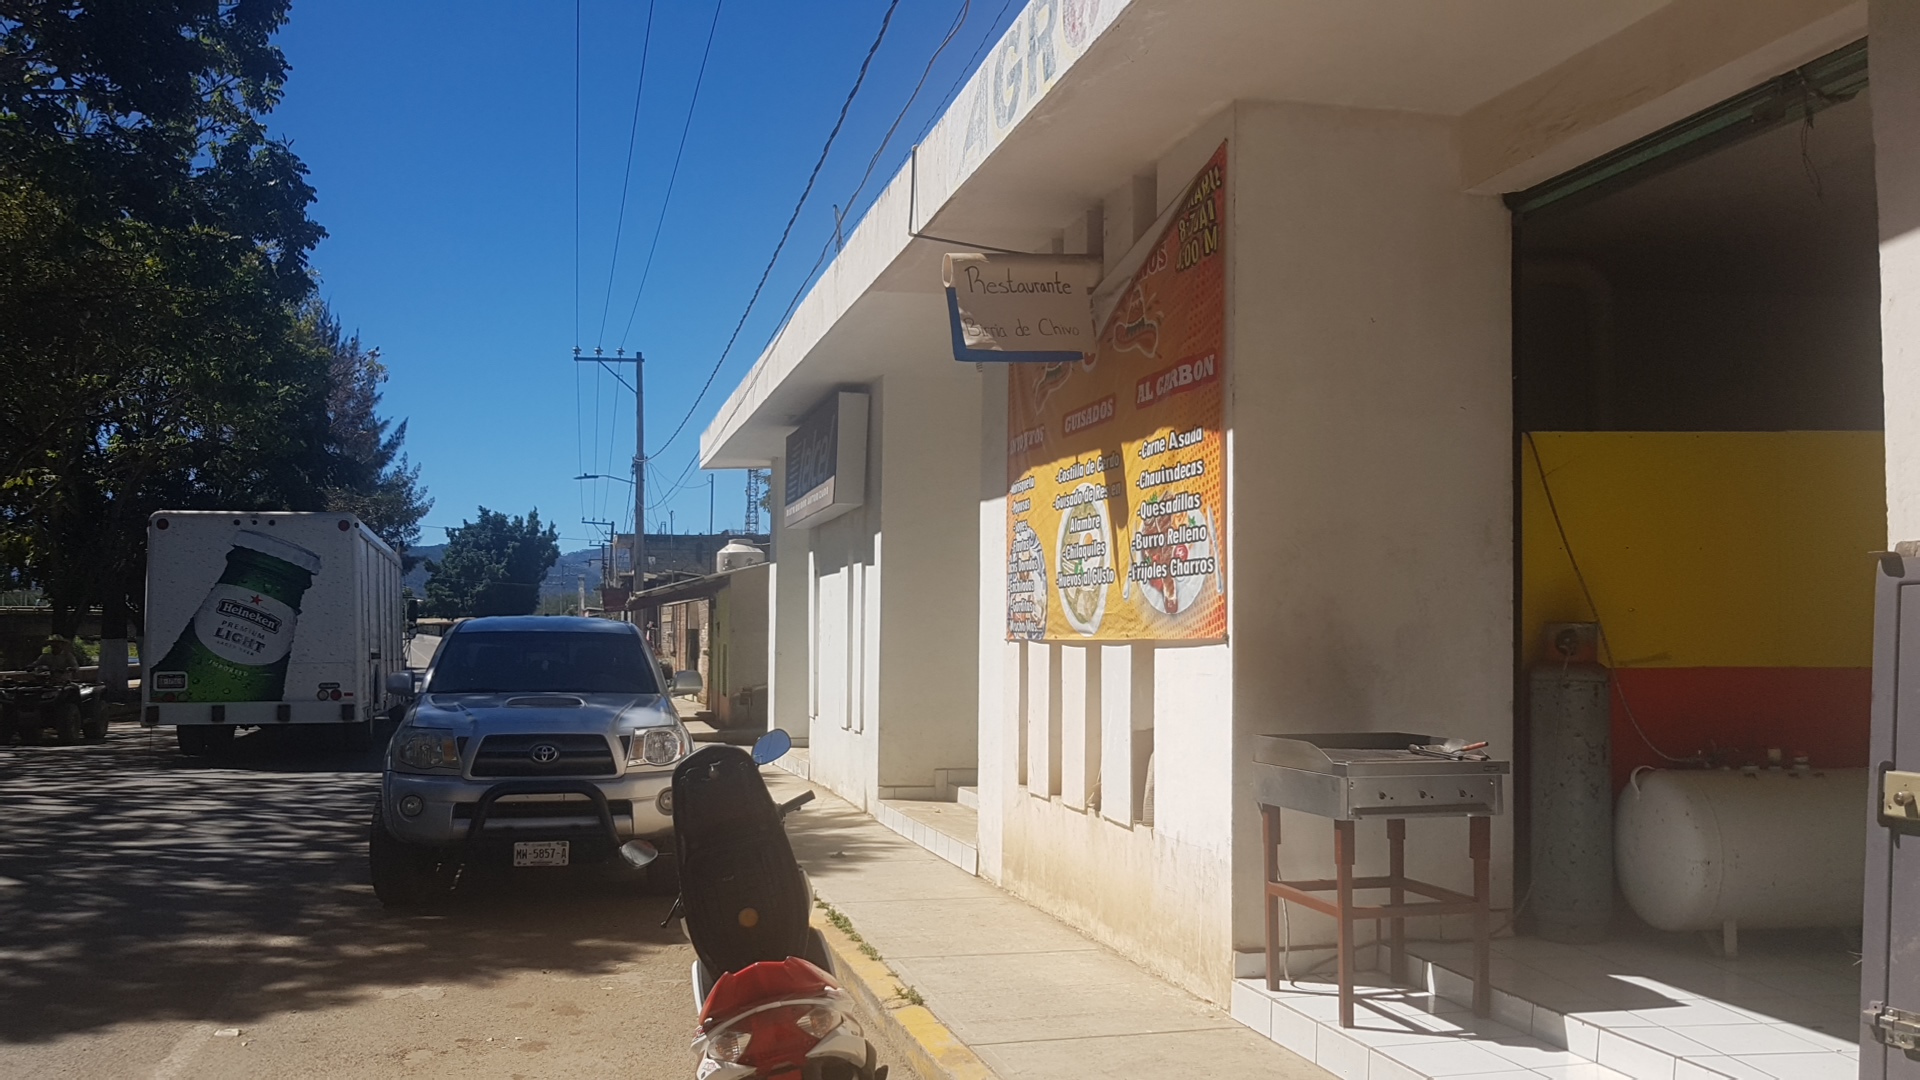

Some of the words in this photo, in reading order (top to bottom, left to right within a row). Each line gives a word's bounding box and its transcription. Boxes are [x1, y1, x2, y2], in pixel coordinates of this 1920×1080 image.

[964, 265, 1072, 295] Restaurante
[1015, 318, 1030, 336] de
[1038, 318, 1080, 336] Chivo
[1137, 384, 1154, 403] AL
[1156, 354, 1215, 396] CARBON
[1064, 398, 1114, 433] GUISADOS
[1085, 459, 1095, 475] de
[1084, 487, 1093, 502] de
[1095, 484, 1108, 501] Res
[1167, 526, 1207, 546] Relleno
[1170, 557, 1215, 577] Charros
[222, 602, 275, 629] Heineken
[213, 627, 266, 653] LIGHT
[221, 620, 265, 640] PREMIUM
